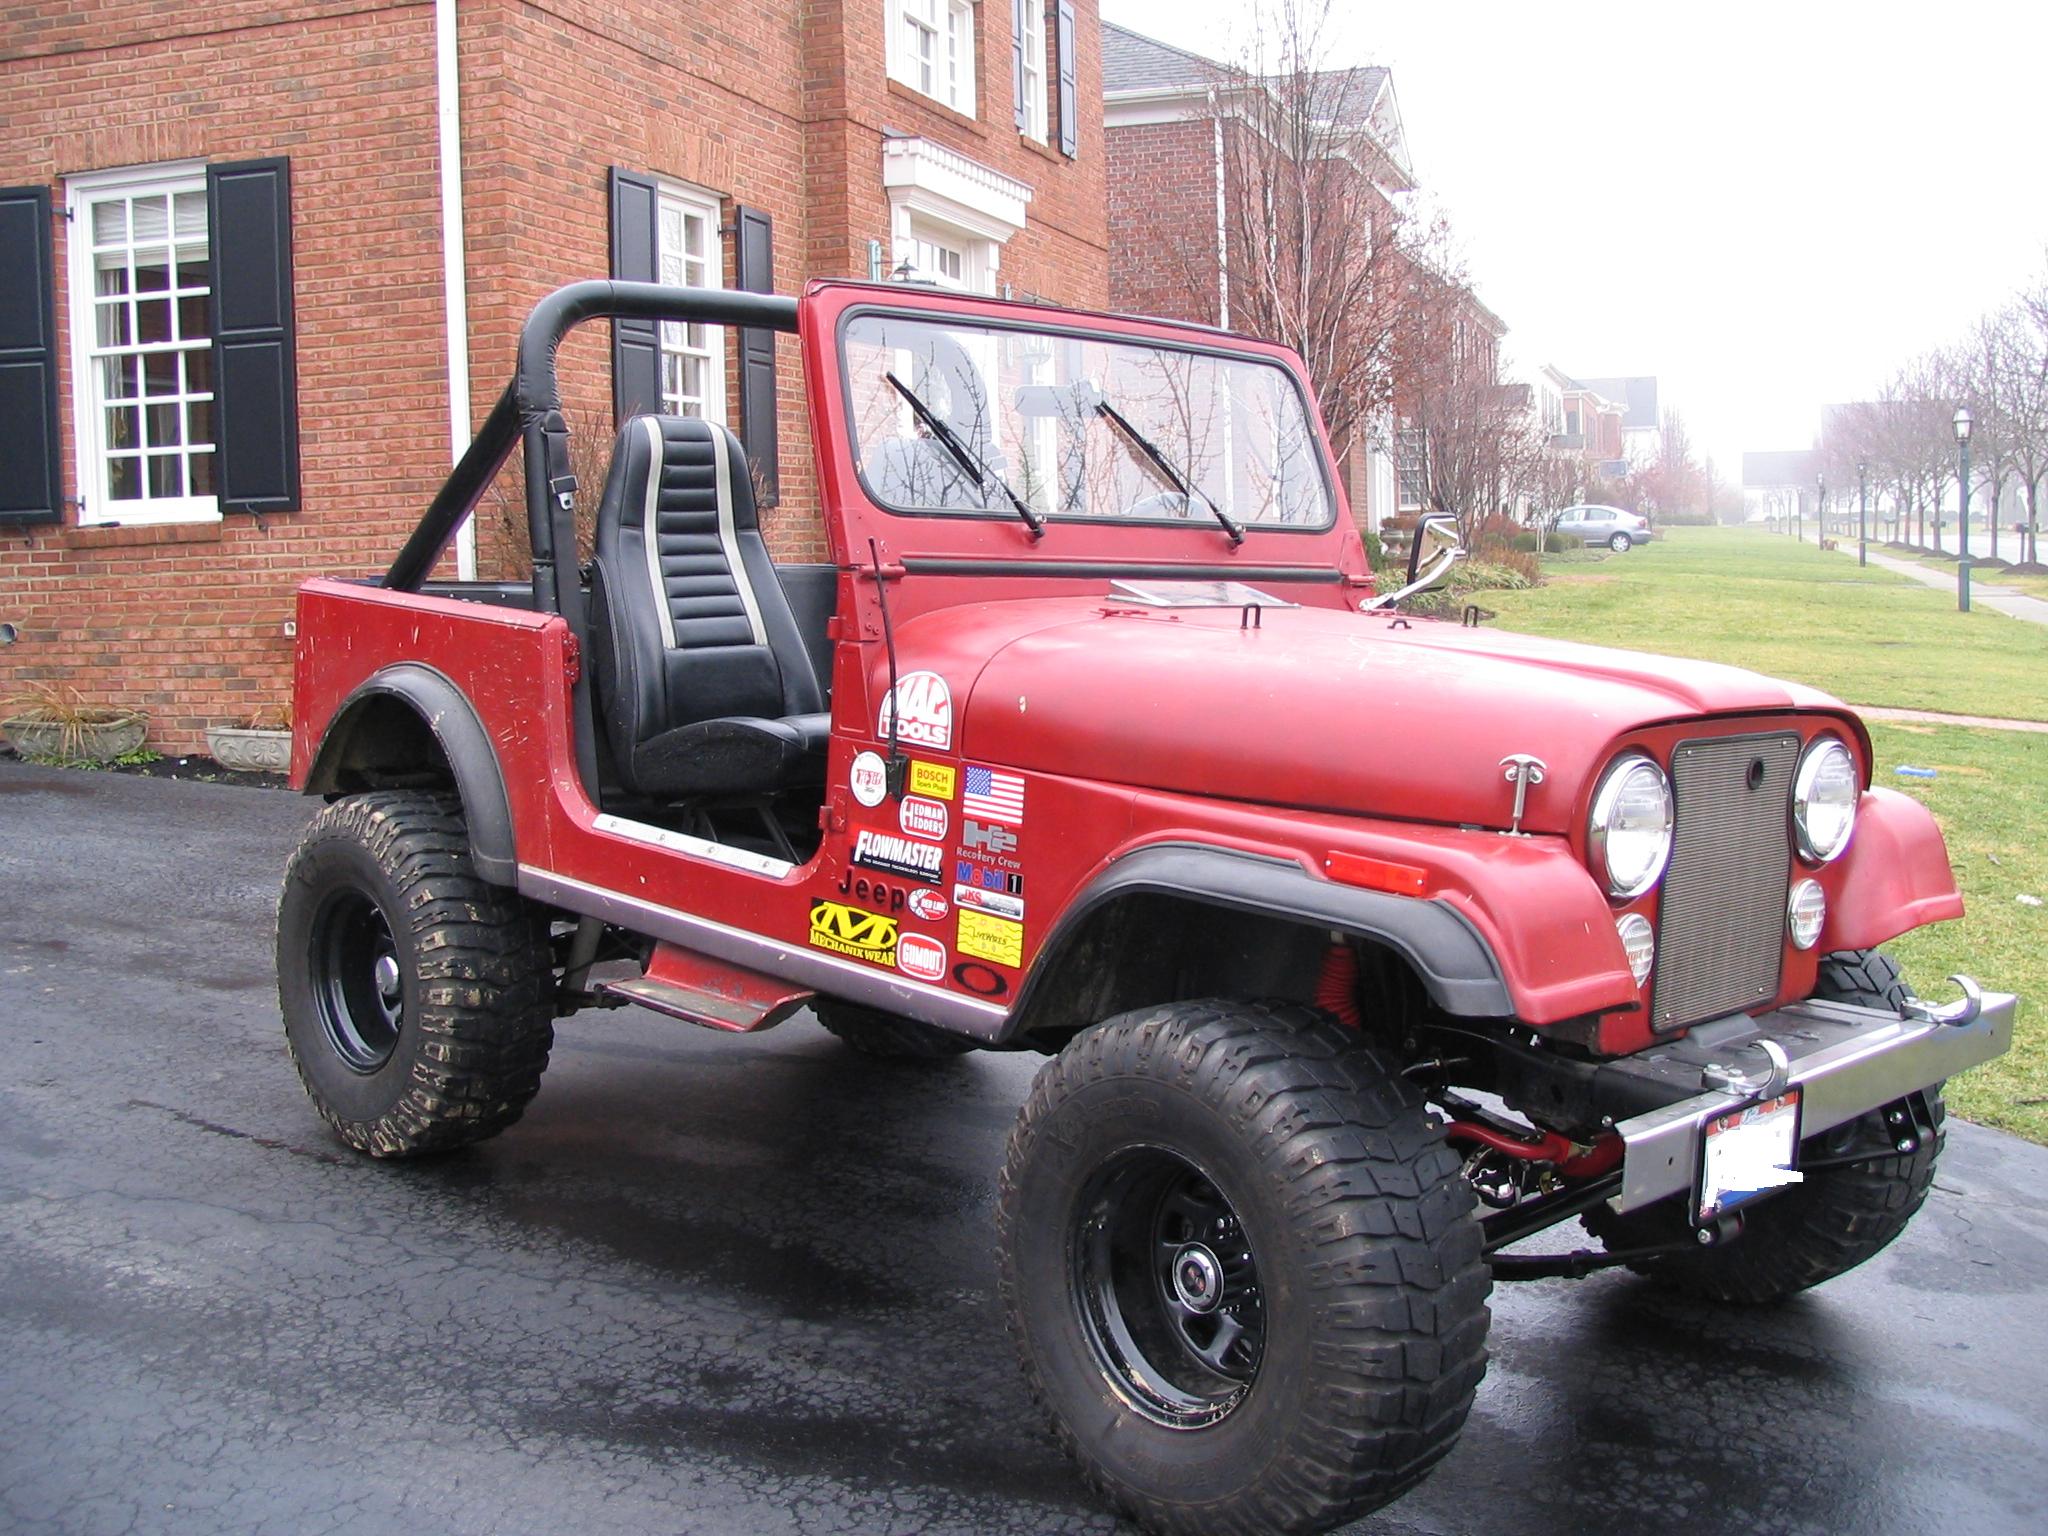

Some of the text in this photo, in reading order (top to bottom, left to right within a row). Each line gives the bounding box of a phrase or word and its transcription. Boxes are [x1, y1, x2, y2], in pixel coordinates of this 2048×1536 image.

[883, 675, 949, 728] MAC
[883, 716, 948, 744] TOOLS
[917, 768, 948, 784] BOSCH
[903, 801, 943, 823] HEDMAN
[854, 830, 943, 871] FLOWMASTER
[998, 856, 1022, 869] Crew
[838, 865, 906, 912] Jeep
[957, 860, 1005, 891] Mobil
[810, 929, 896, 967] MECHANIX WEAR
[903, 943, 941, 971] GUMOUT
